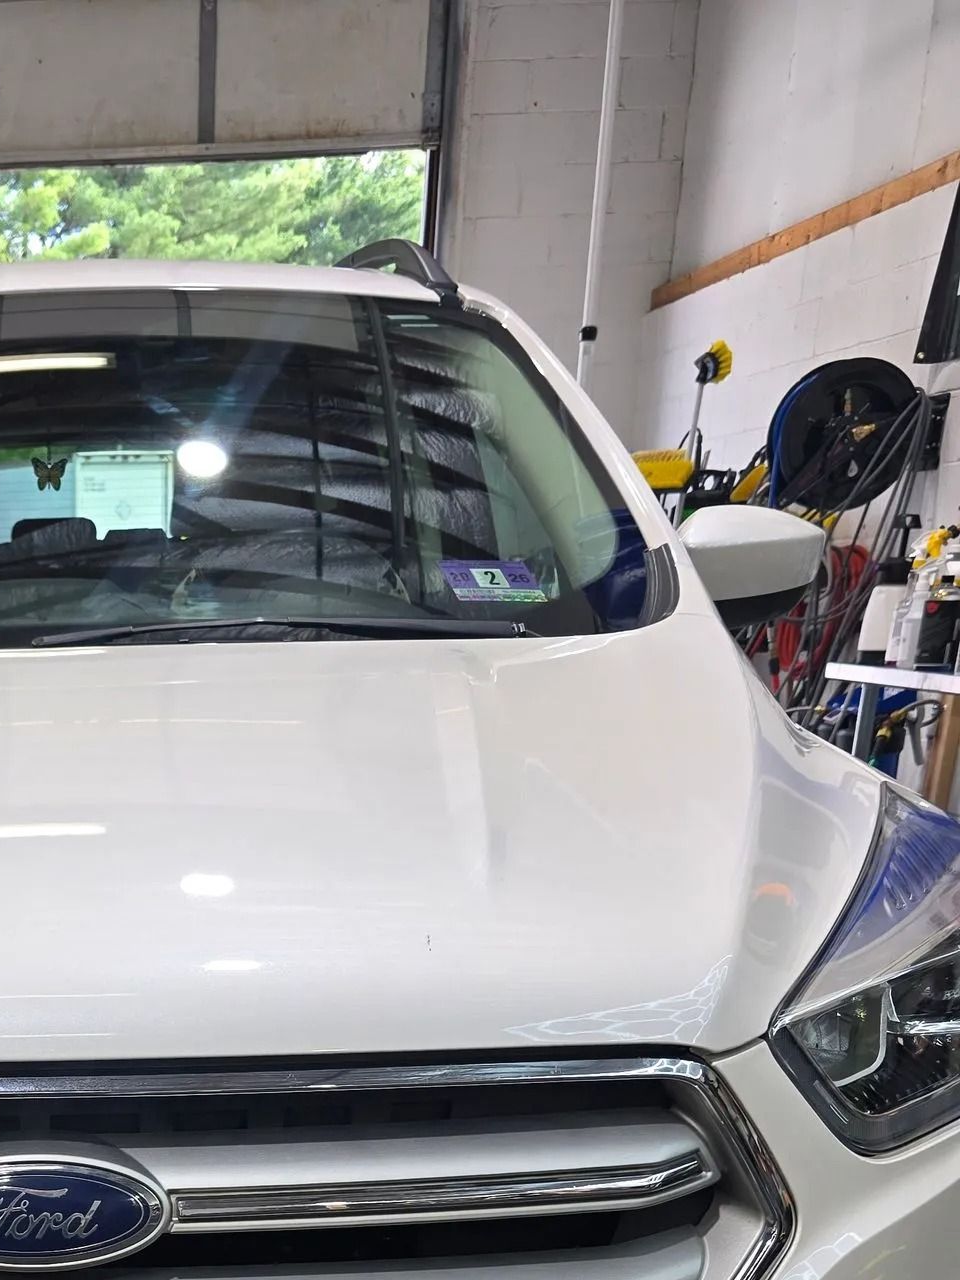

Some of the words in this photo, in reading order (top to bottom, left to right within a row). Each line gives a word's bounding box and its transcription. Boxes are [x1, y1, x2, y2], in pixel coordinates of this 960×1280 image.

[450, 571, 470, 583] 20
[484, 570, 501, 586] 2
[507, 573, 531, 584] 26
